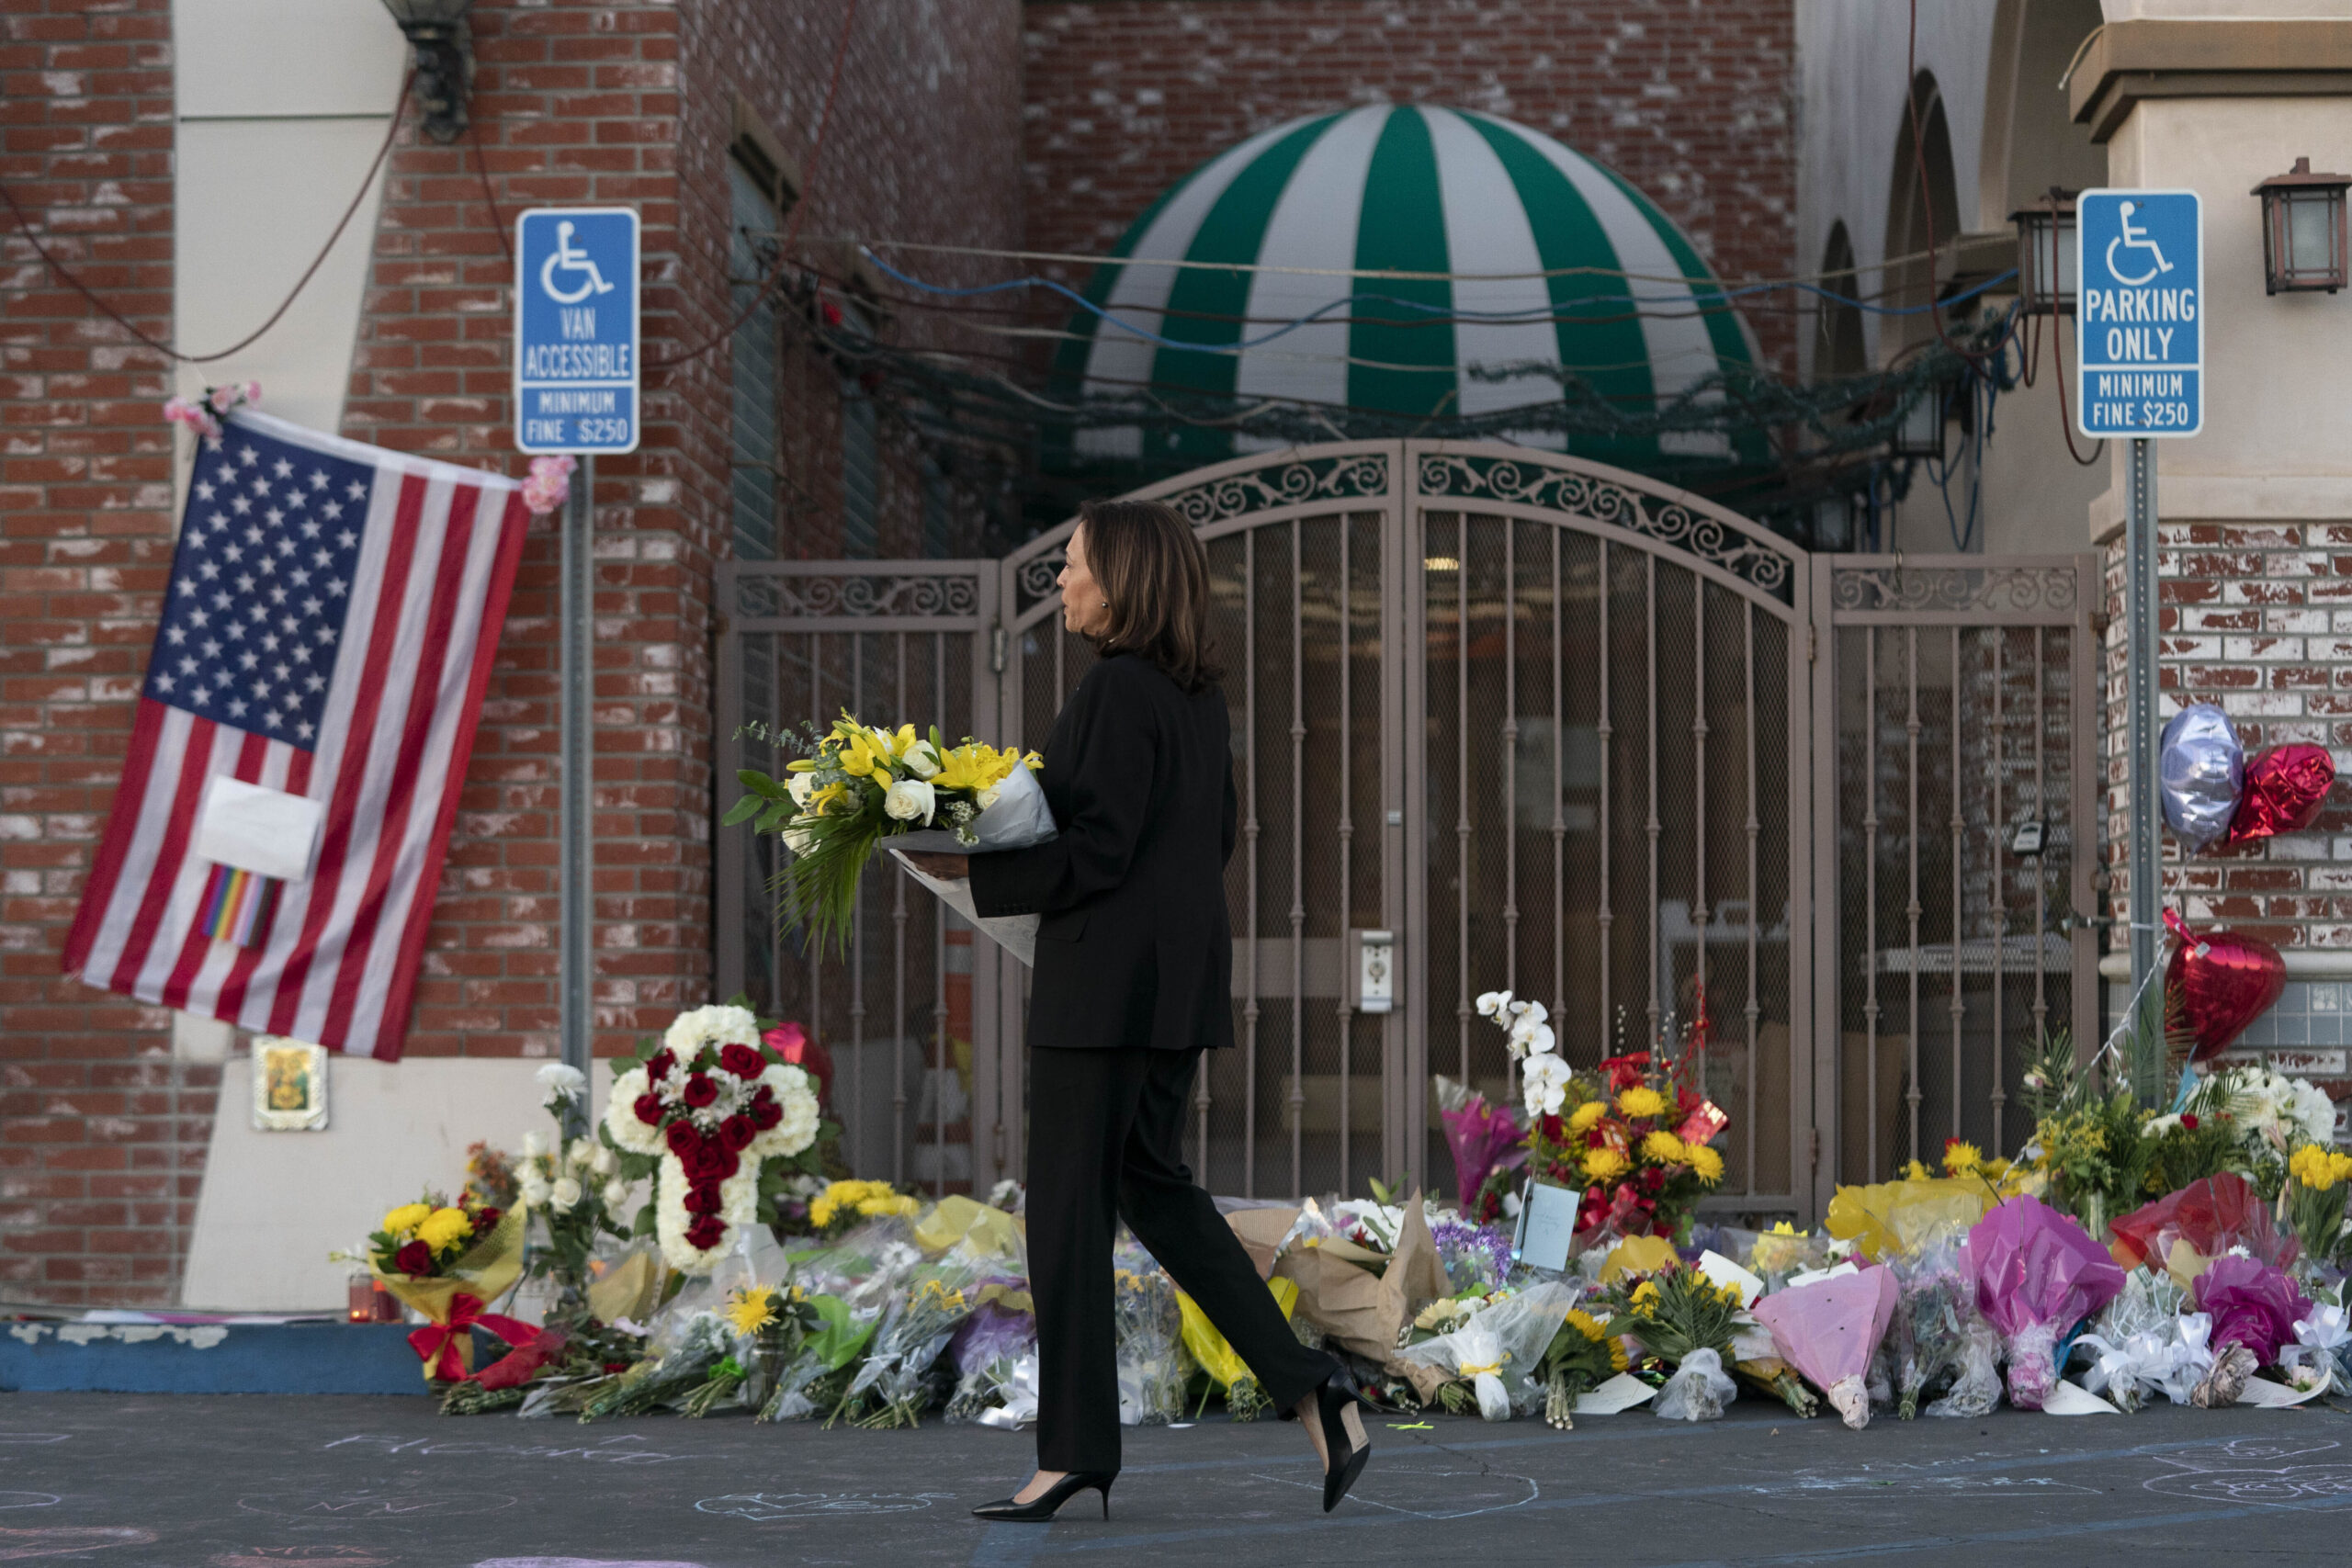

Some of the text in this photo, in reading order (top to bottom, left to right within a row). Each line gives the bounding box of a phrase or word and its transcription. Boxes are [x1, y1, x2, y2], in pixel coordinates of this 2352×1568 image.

[2086, 288, 2195, 322] PARKING
[560, 307, 596, 341] VAN
[2107, 327, 2174, 361] ONLY
[526, 344, 630, 378] ACCESSIBLE
[2098, 373, 2183, 398] MINIMUM
[538, 390, 616, 413] MINIMUM
[2093, 400, 2188, 428] FINE $250
[526, 417, 628, 443] FINE $250
